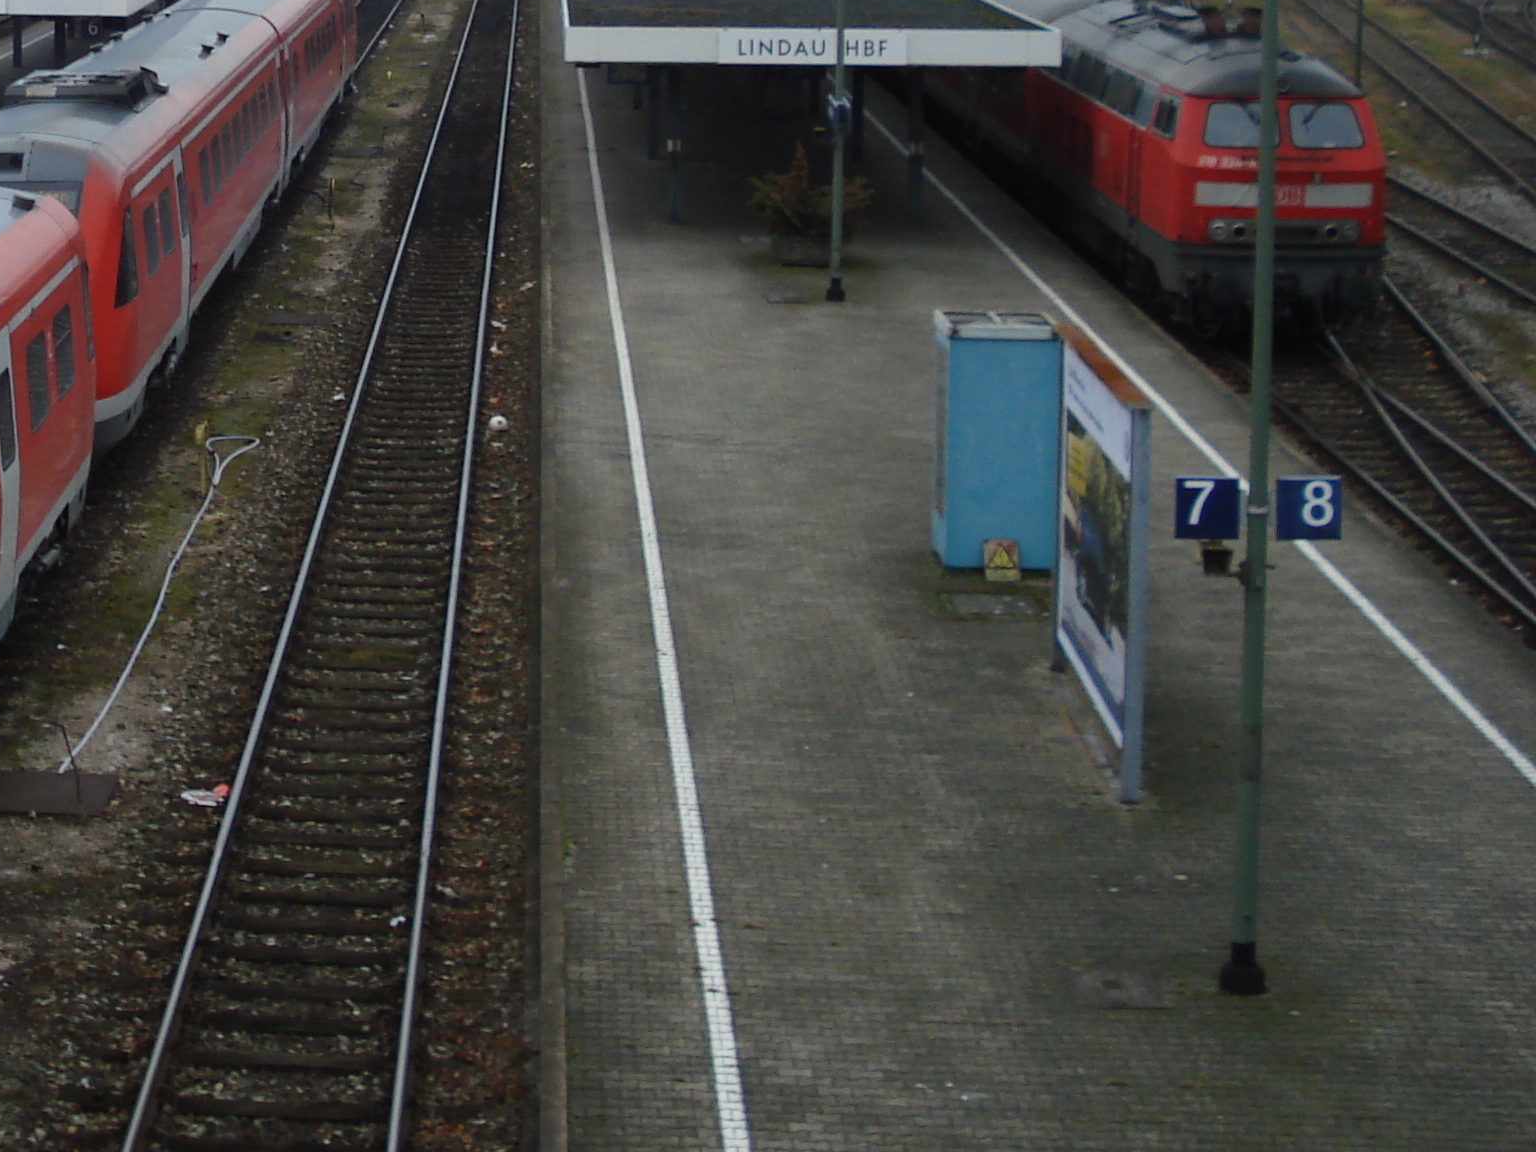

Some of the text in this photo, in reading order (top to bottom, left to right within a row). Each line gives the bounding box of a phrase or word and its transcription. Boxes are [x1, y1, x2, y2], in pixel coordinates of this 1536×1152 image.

[88, 21, 99, 36] 6
[738, 39, 888, 57] LINDAU HBF
[1184, 480, 1215, 526] 7
[1301, 480, 1335, 527] 8
